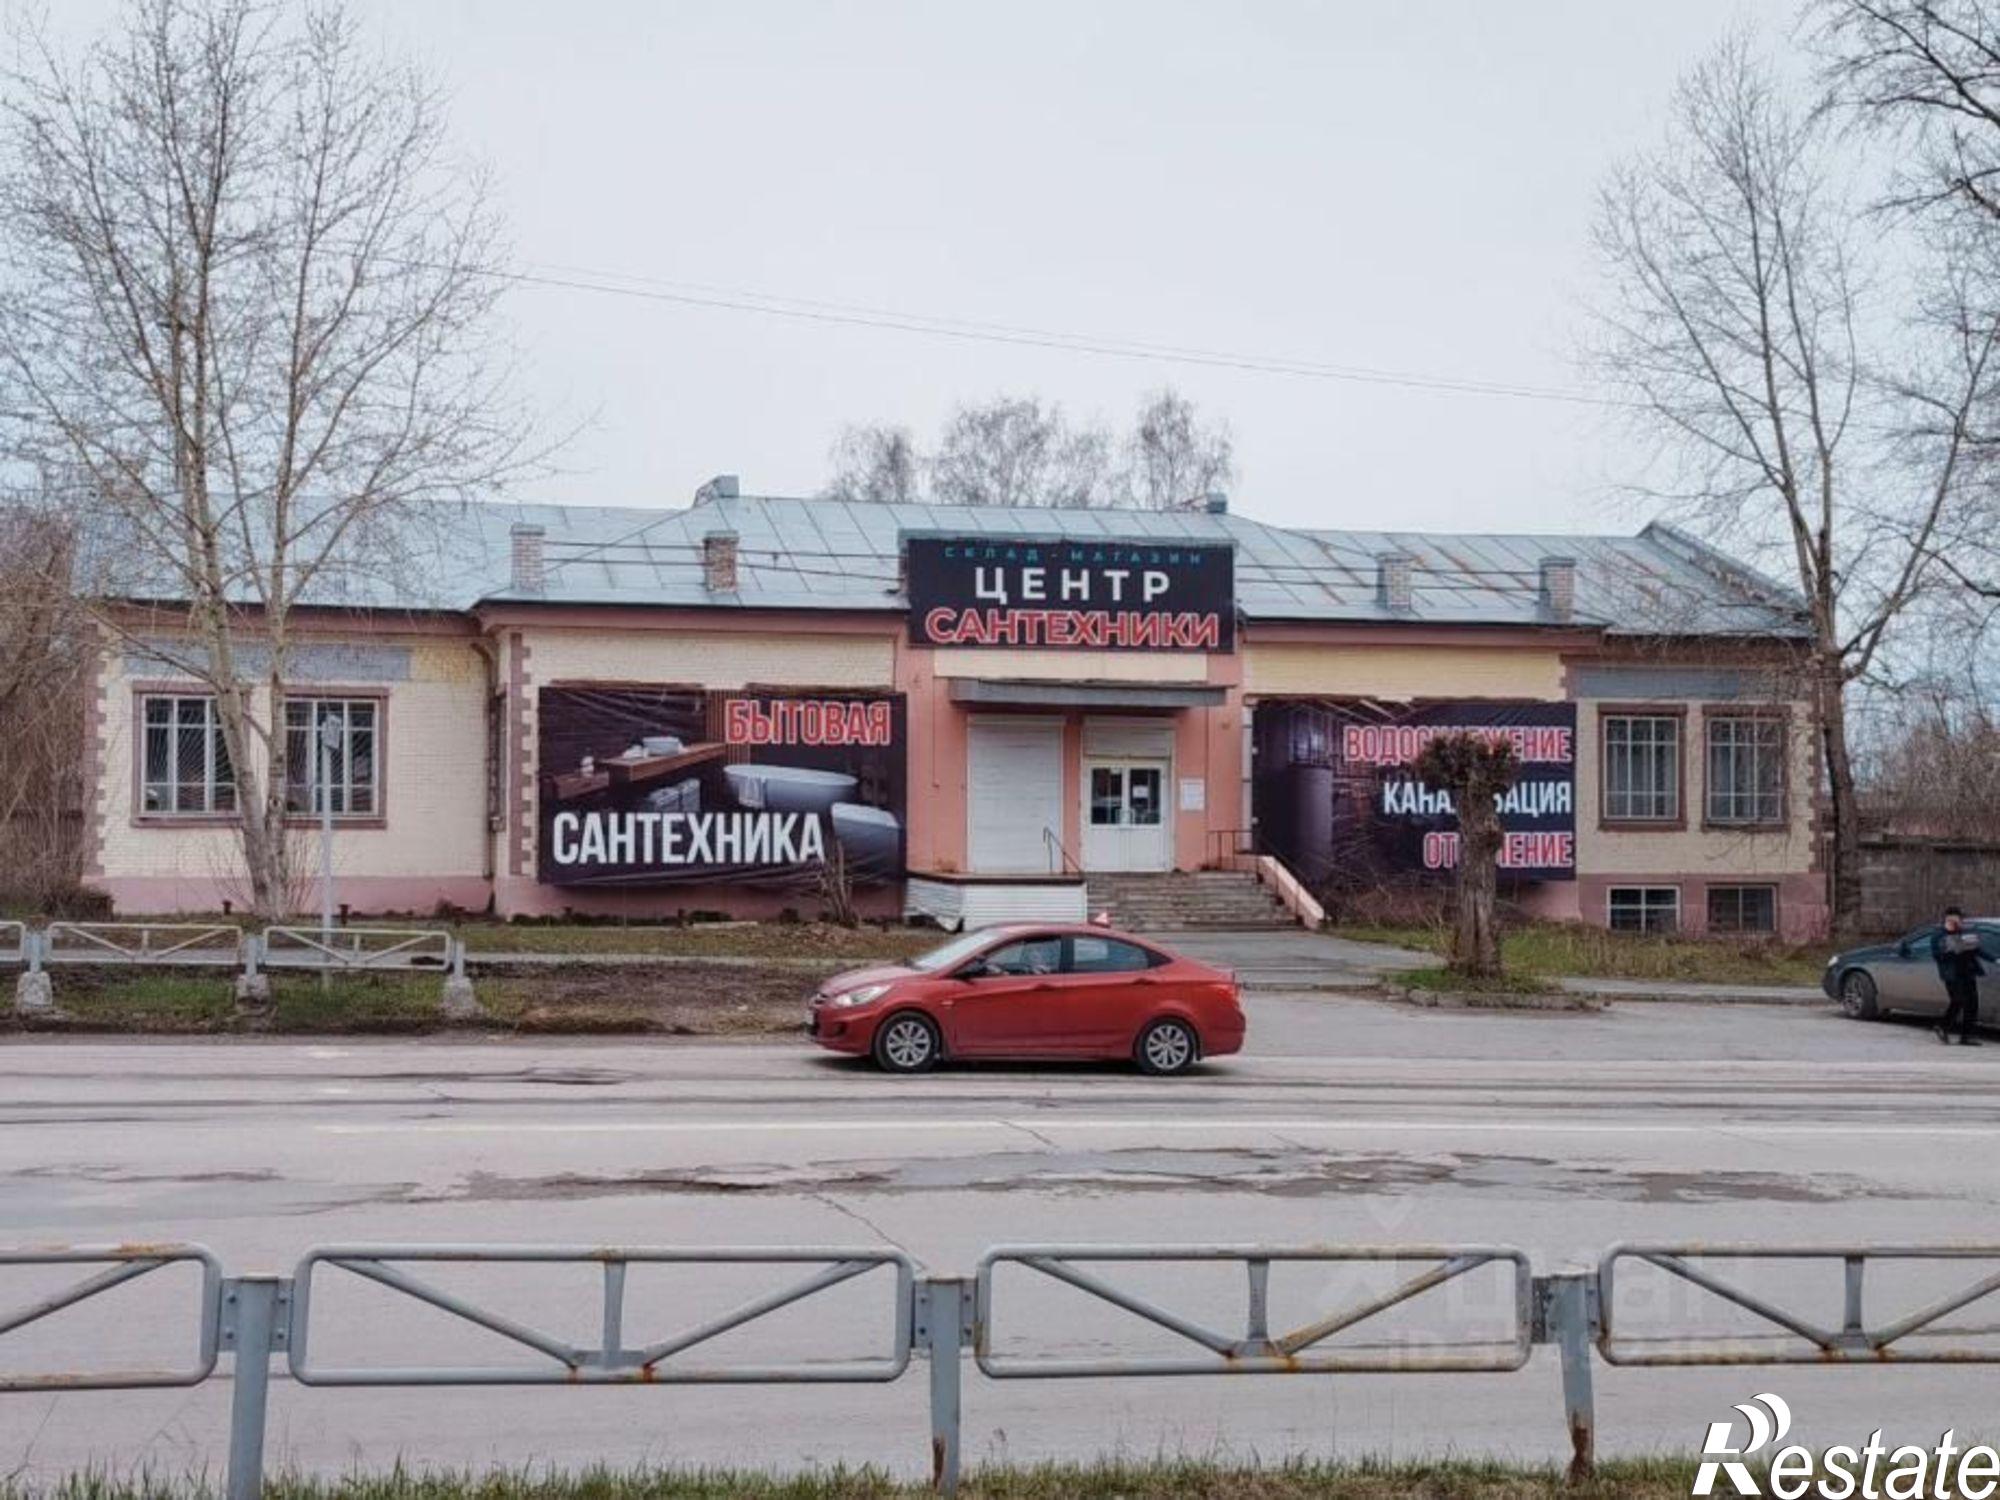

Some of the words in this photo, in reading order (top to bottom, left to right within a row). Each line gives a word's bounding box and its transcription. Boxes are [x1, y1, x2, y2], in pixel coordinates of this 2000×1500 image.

[975, 567, 1170, 605] ЦЕНТР
[925, 607, 1219, 646] САНТЕХНИКИ
[725, 699, 891, 746] БЫТОВАЯ
[1383, 781, 1571, 818] КАНААЦИЯ
[553, 812, 825, 864] САНТЕХНИКА
[1424, 832, 1573, 868] ОТЕНИЕ
